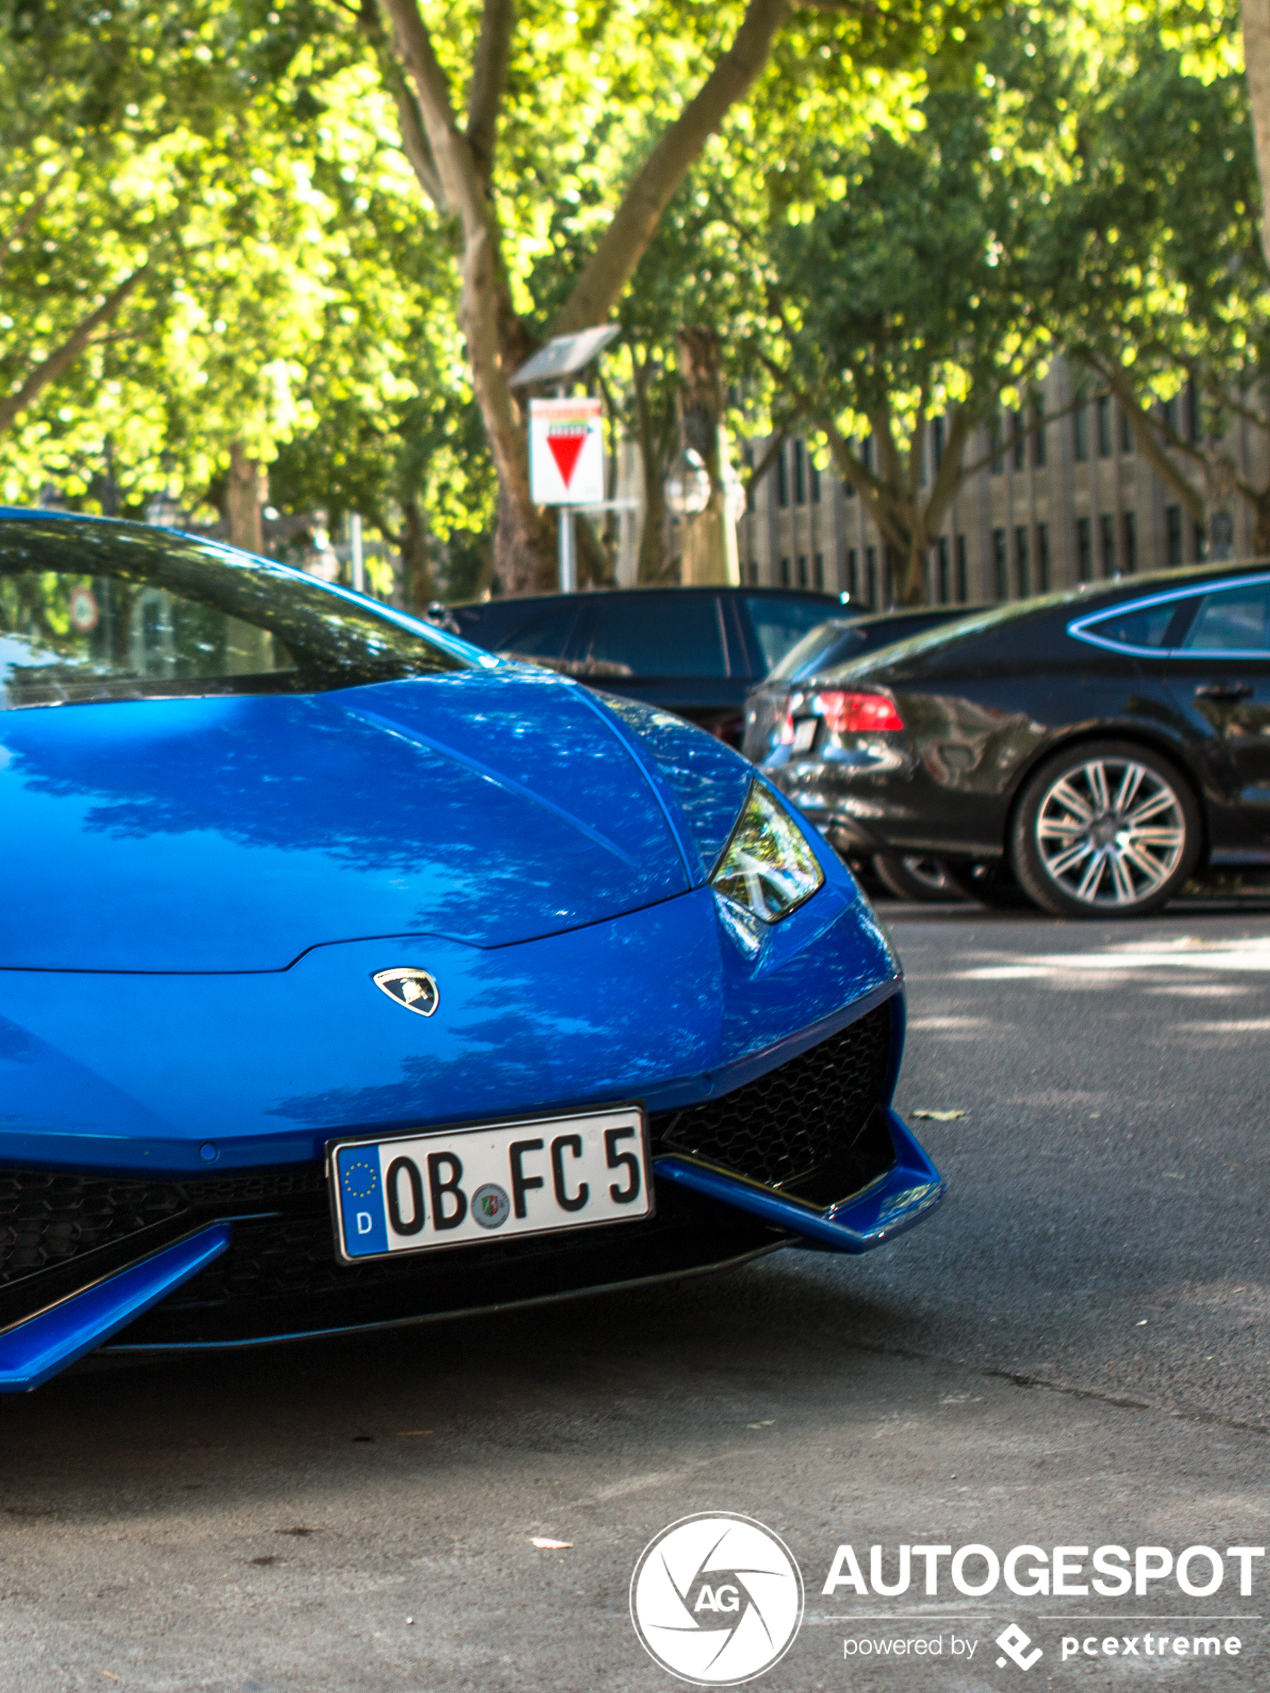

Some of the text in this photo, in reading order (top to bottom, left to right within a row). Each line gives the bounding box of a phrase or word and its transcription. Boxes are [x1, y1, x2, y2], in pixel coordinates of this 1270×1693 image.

[386, 1151, 468, 1237] OB
[509, 1133, 590, 1220] FC
[604, 1126, 641, 1204] 5
[356, 1212, 373, 1235] D
